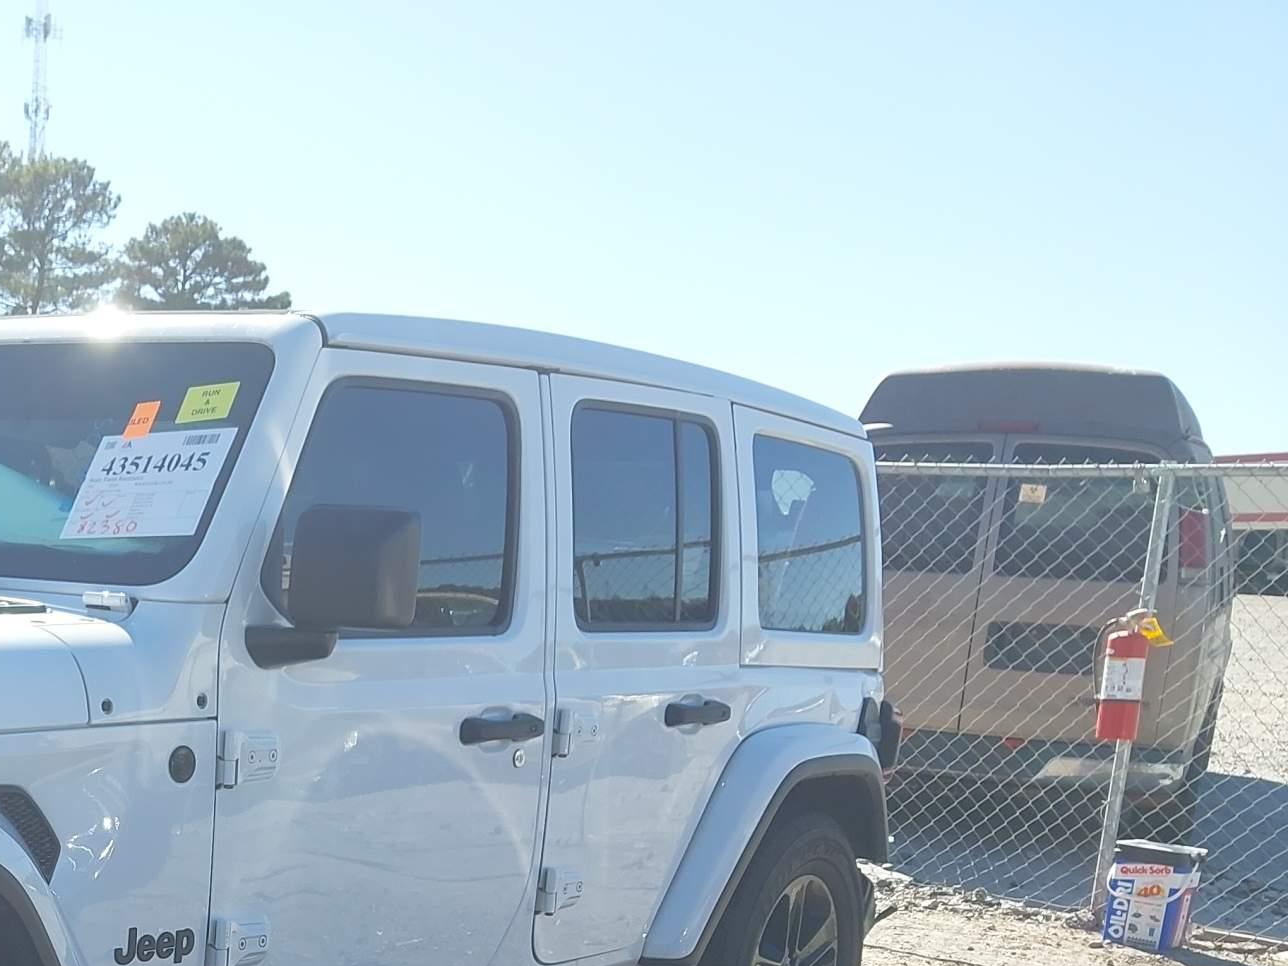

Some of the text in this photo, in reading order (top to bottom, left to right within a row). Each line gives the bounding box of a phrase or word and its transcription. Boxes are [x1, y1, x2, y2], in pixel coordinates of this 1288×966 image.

[202, 389, 221, 397] RUN
[192, 407, 217, 415] DRIVE
[101, 451, 211, 475] 43514045
[1120, 865, 1172, 875] Quick Sorb
[114, 927, 195, 966] Jeep
